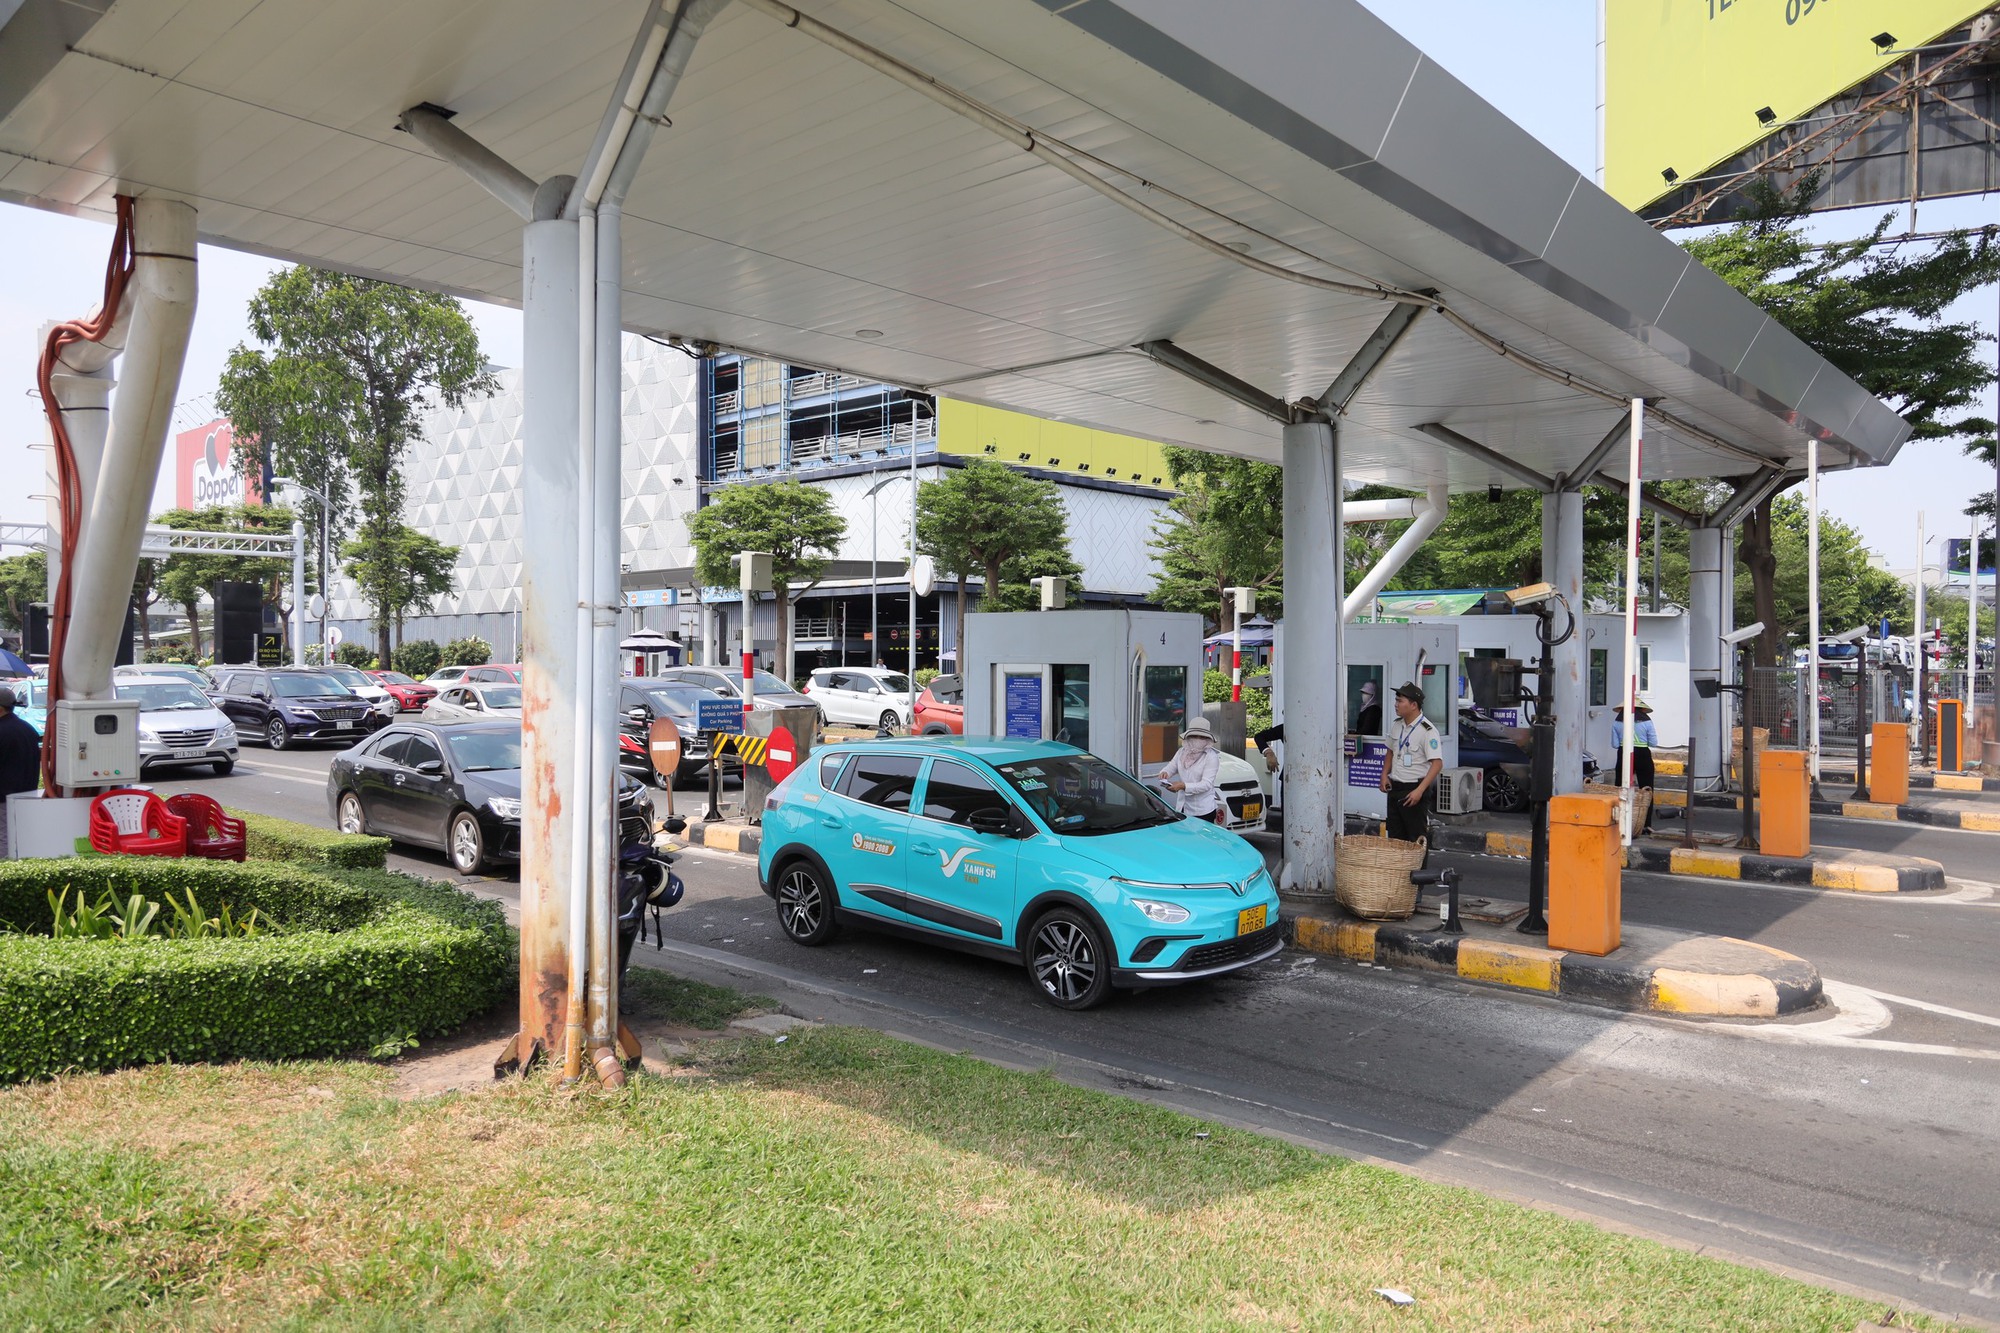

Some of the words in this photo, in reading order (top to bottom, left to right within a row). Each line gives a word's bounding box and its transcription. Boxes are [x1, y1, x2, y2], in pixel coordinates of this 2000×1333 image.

[1159, 631, 1166, 645] 4
[1017, 778, 1038, 786] TAXI
[964, 863, 984, 876] XANH
[985, 868, 996, 879] SM
[1246, 907, 1259, 921] 50E
